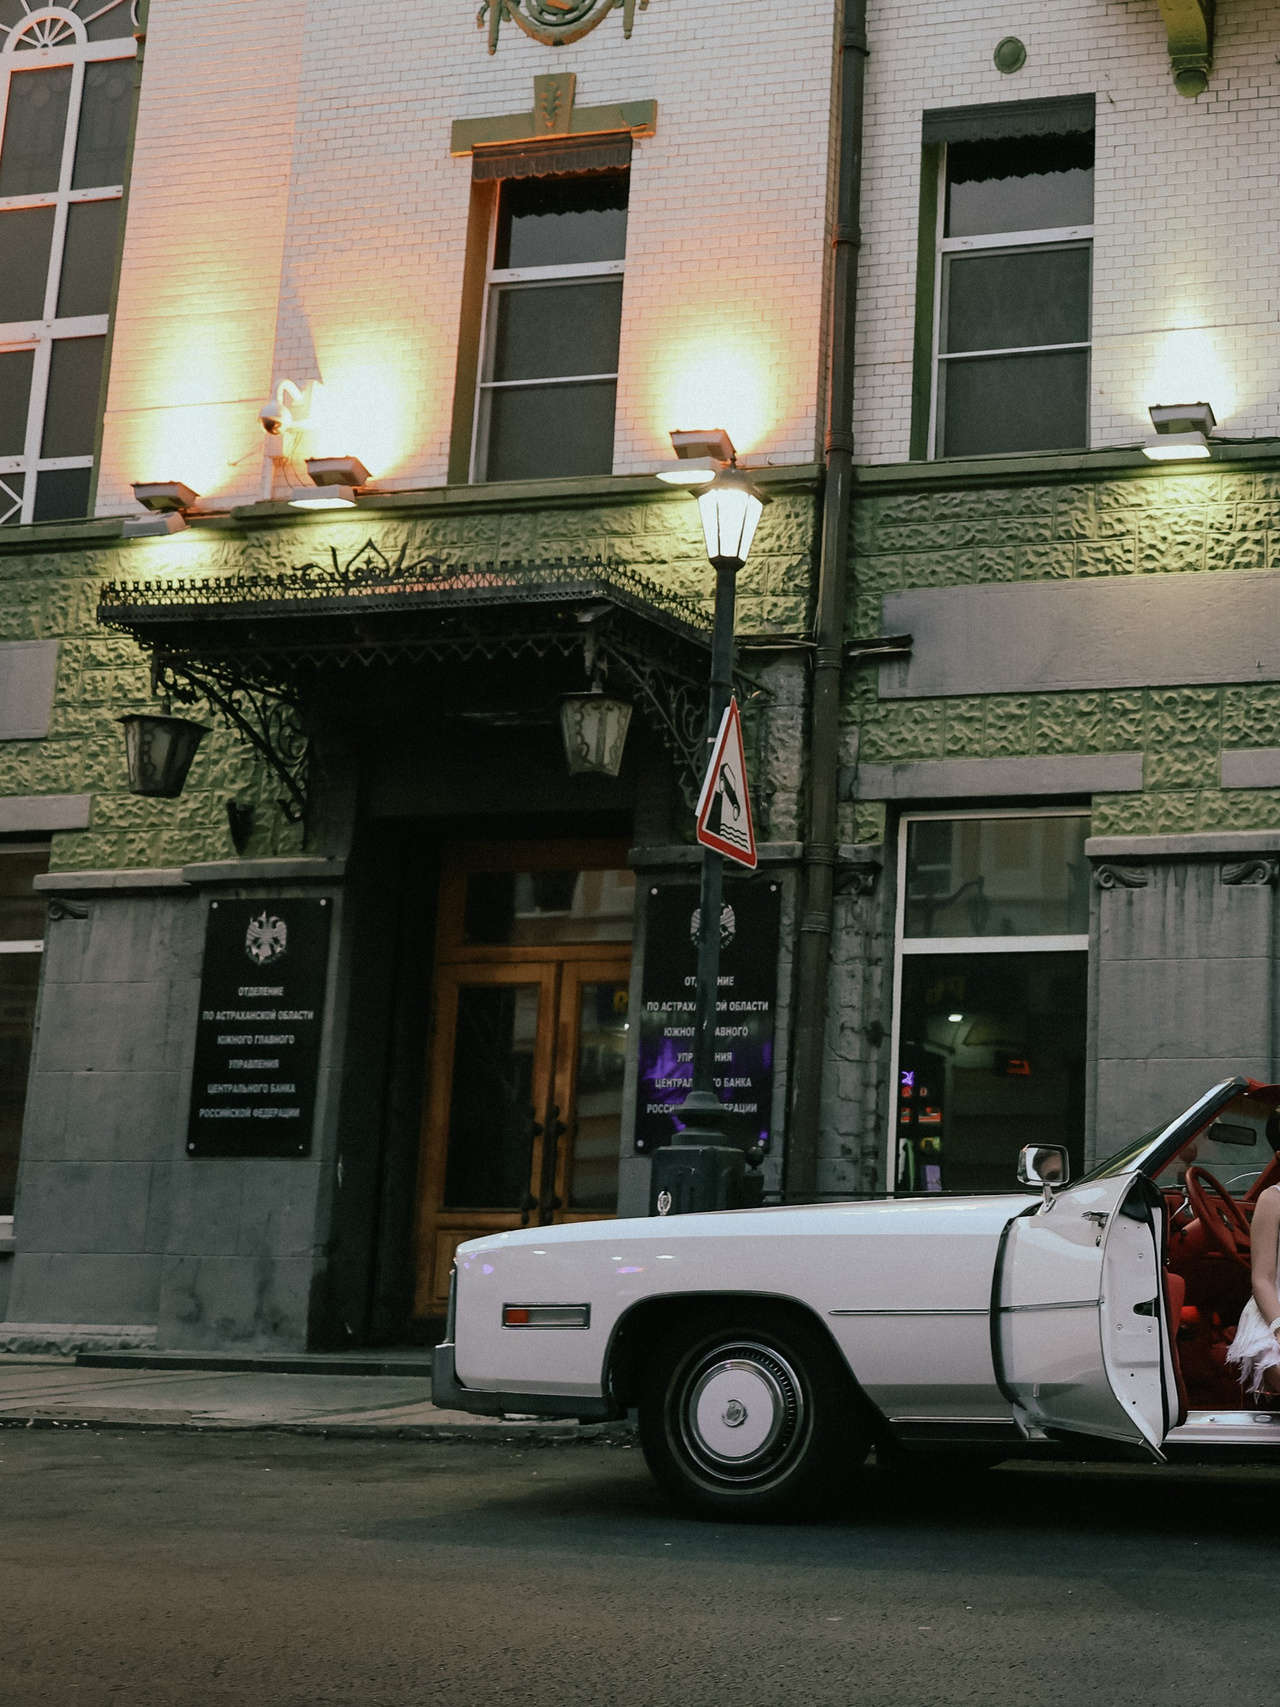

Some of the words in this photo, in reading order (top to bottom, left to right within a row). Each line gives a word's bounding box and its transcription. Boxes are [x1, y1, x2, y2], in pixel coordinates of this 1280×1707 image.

[684, 976, 735, 988] ОТНИЕ
[238, 986, 284, 997] ОТДЕЛЕНИЕ
[647, 1001, 659, 1012] ПО
[661, 1000, 728, 1012] АСТРАХОЙ
[729, 1001, 769, 1012] ОБЛАСТИ
[203, 1010, 215, 1020] ПО
[278, 1010, 314, 1020] ОБЛАСТИ
[664, 1026, 696, 1037] ЮЖНОГ
[714, 1025, 749, 1037] АВНОГО
[217, 1034, 253, 1045] ЮЖНОГО
[254, 1034, 295, 1045] ГЛАВНОГО
[677, 1052, 733, 1062] УПРНИЯ
[270, 1083, 296, 1093] БАНКА
[655, 1078, 722, 1089] ЦЕНТРАЛО
[723, 1077, 752, 1088] БАНКА
